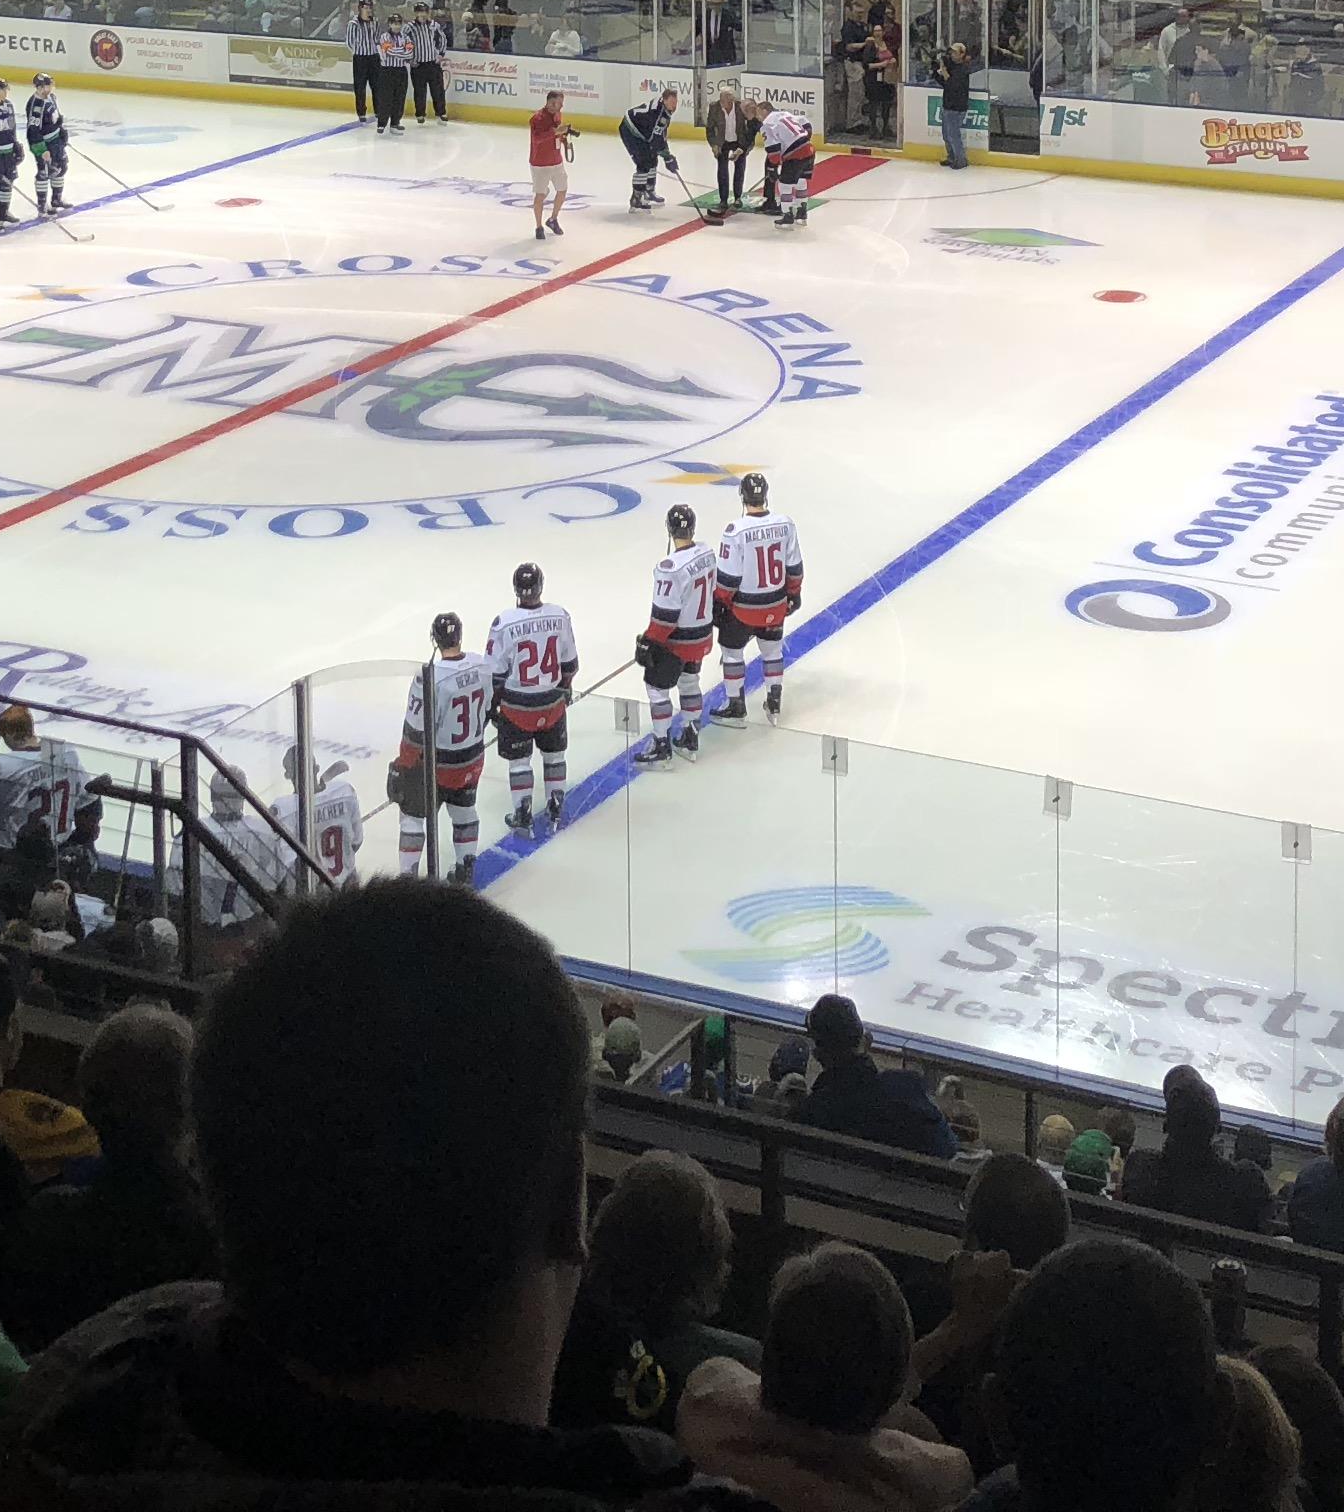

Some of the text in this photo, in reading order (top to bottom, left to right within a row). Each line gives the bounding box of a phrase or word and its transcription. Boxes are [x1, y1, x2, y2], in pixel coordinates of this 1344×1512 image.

[454, 79, 518, 97] DENTAL
[765, 89, 816, 105] MAINE
[1227, 141, 1286, 155] STADIUM
[126, 254, 863, 402] CROSS ARENA
[64, 481, 643, 539] CROSS
[745, 525, 789, 544] MACARTHUR
[755, 542, 783, 589] 16
[656, 580, 673, 597] 77
[509, 618, 563, 640] KRAVCHENKO
[517, 635, 559, 687] 24
[408, 694, 423, 716] 37
[451, 688, 485, 745] 37
[321, 825, 343, 878] 9
